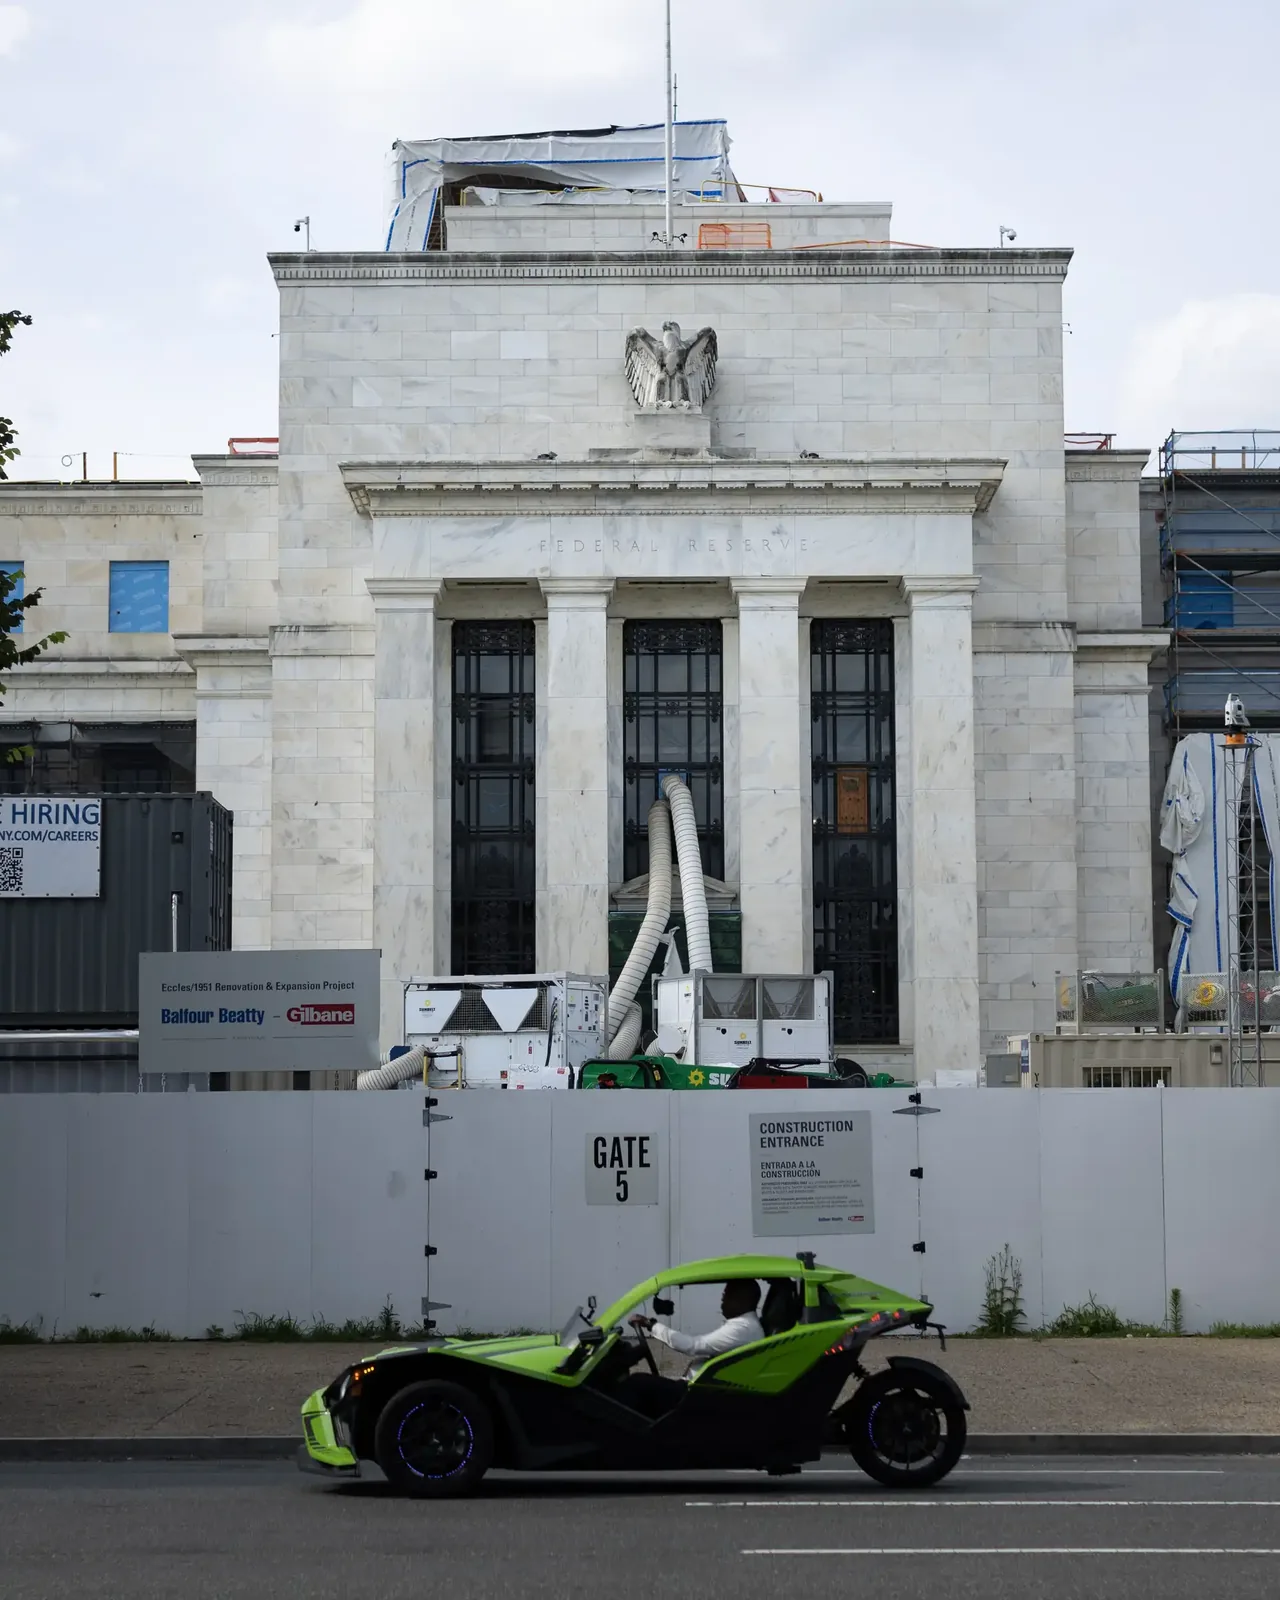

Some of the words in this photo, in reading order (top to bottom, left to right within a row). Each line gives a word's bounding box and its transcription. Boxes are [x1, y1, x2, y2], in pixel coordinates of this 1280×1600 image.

[540, 540, 658, 553] FEDERAL
[688, 539, 808, 552] RESERVE
[11, 803, 99, 825] HIRING
[161, 982, 213, 993] Eccles/1951
[215, 982, 264, 992] Renovation
[265, 982, 274, 991] &
[275, 982, 321, 993] Expansion
[323, 981, 355, 992] Project
[161, 1008, 214, 1024] Balfour
[218, 1007, 265, 1026] Beatty
[286, 1006, 354, 1023] Gilbane
[1188, 1009, 1227, 1022] SUNBELT
[760, 1120, 854, 1134] CONSTRUCTION
[760, 1135, 825, 1148] ENTRANCE
[594, 1136, 651, 1169] GATE
[761, 1161, 797, 1170] ENTRADA
[798, 1161, 805, 1169] A
[761, 1168, 821, 1179] CONSTRUCCIÓN
[616, 1170, 629, 1203] 5
